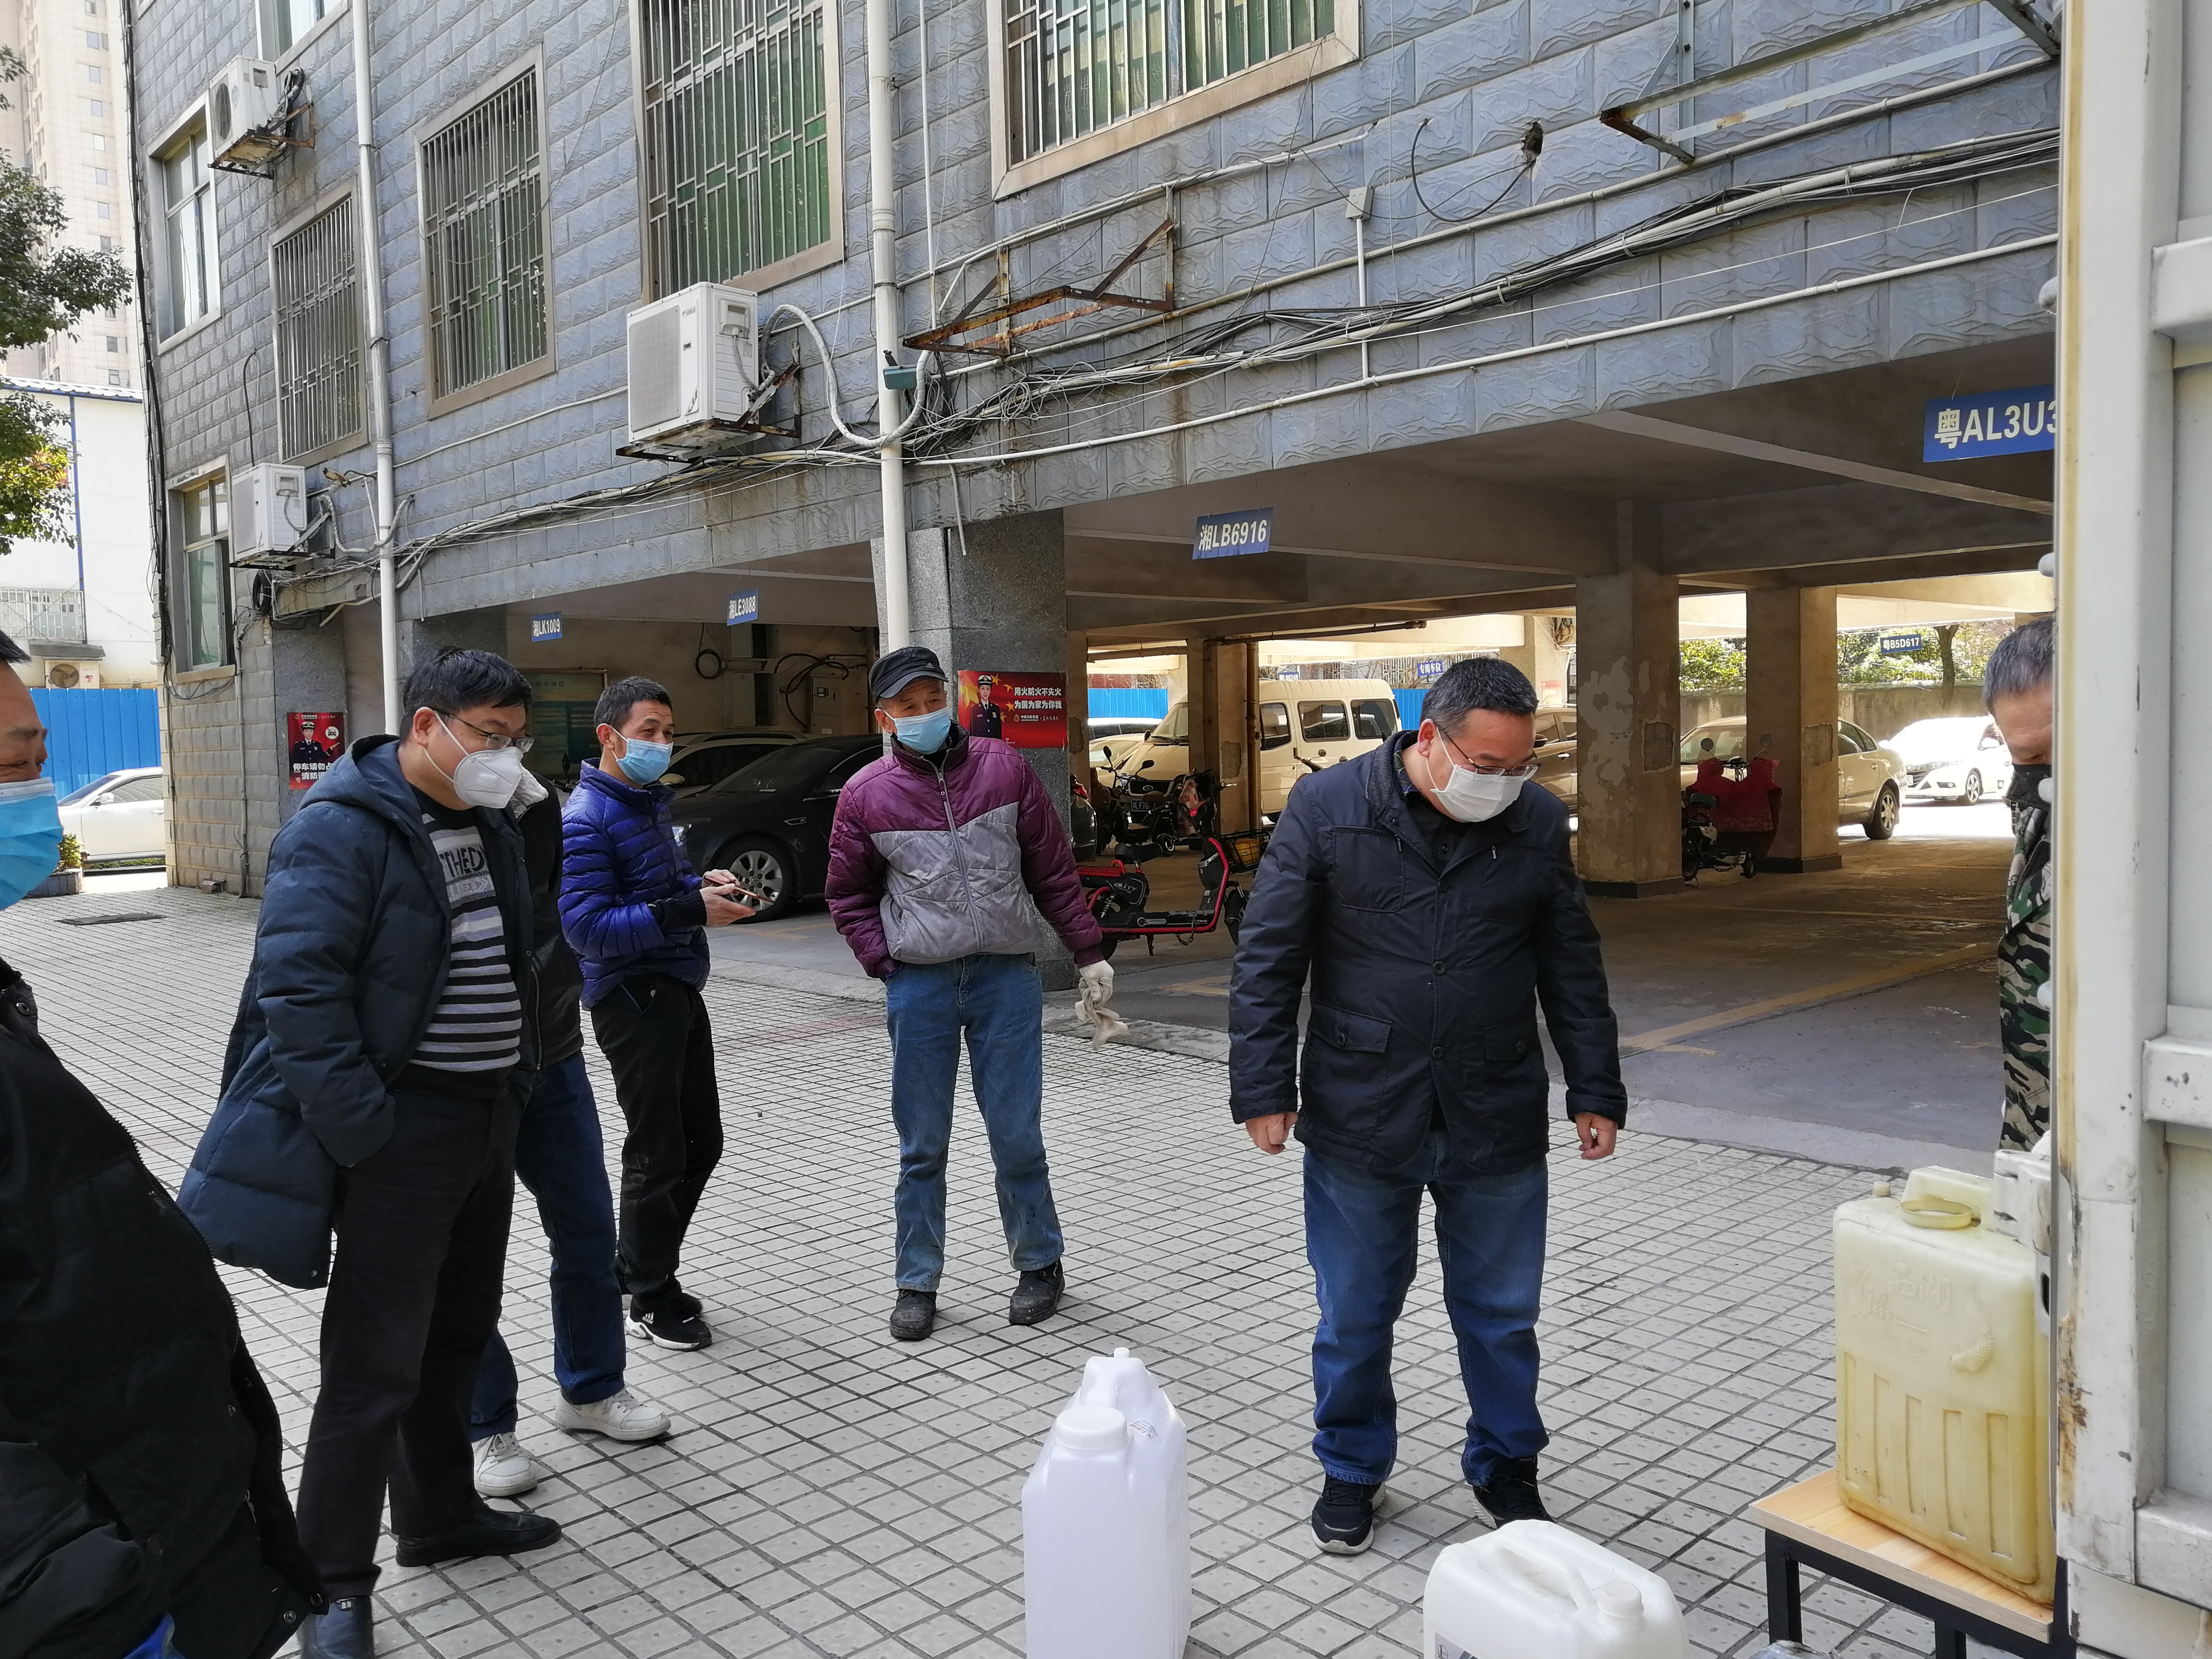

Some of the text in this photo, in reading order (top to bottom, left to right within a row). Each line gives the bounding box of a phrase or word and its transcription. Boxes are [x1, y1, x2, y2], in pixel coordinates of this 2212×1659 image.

[1198, 519, 1267, 551] 湘LB6916
[729, 595, 756, 619] 湘LE3088
[533, 618, 560, 637] 湘LK1009
[1882, 637, 1919, 650] 粤B5D617
[1419, 662, 1442, 674] 专用车位
[1014, 687, 1062, 696] 用火防火不失火
[1014, 700, 1062, 709] 为国为家为你我
